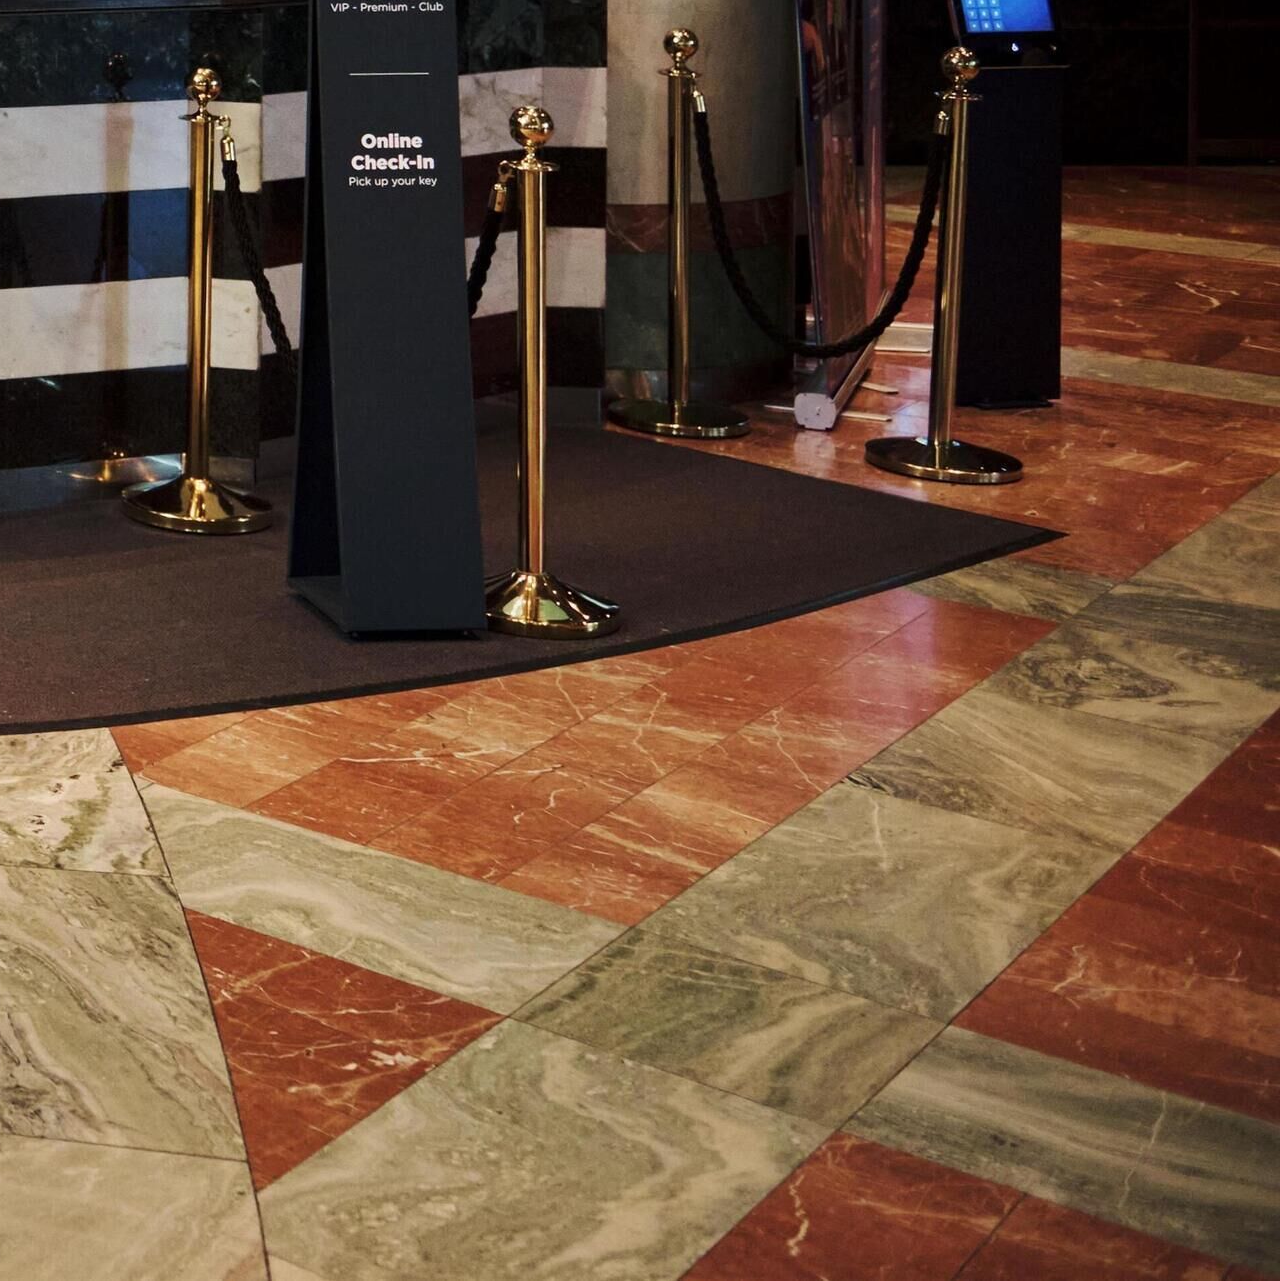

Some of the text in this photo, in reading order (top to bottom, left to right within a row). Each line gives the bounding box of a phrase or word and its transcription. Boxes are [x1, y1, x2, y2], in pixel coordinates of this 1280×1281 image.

[330, 2, 350, 12] VIP
[360, 2, 408, 12] Premium
[418, 1, 444, 12] Club
[361, 133, 423, 149] Online
[349, 176, 437, 188] Pick up your key
